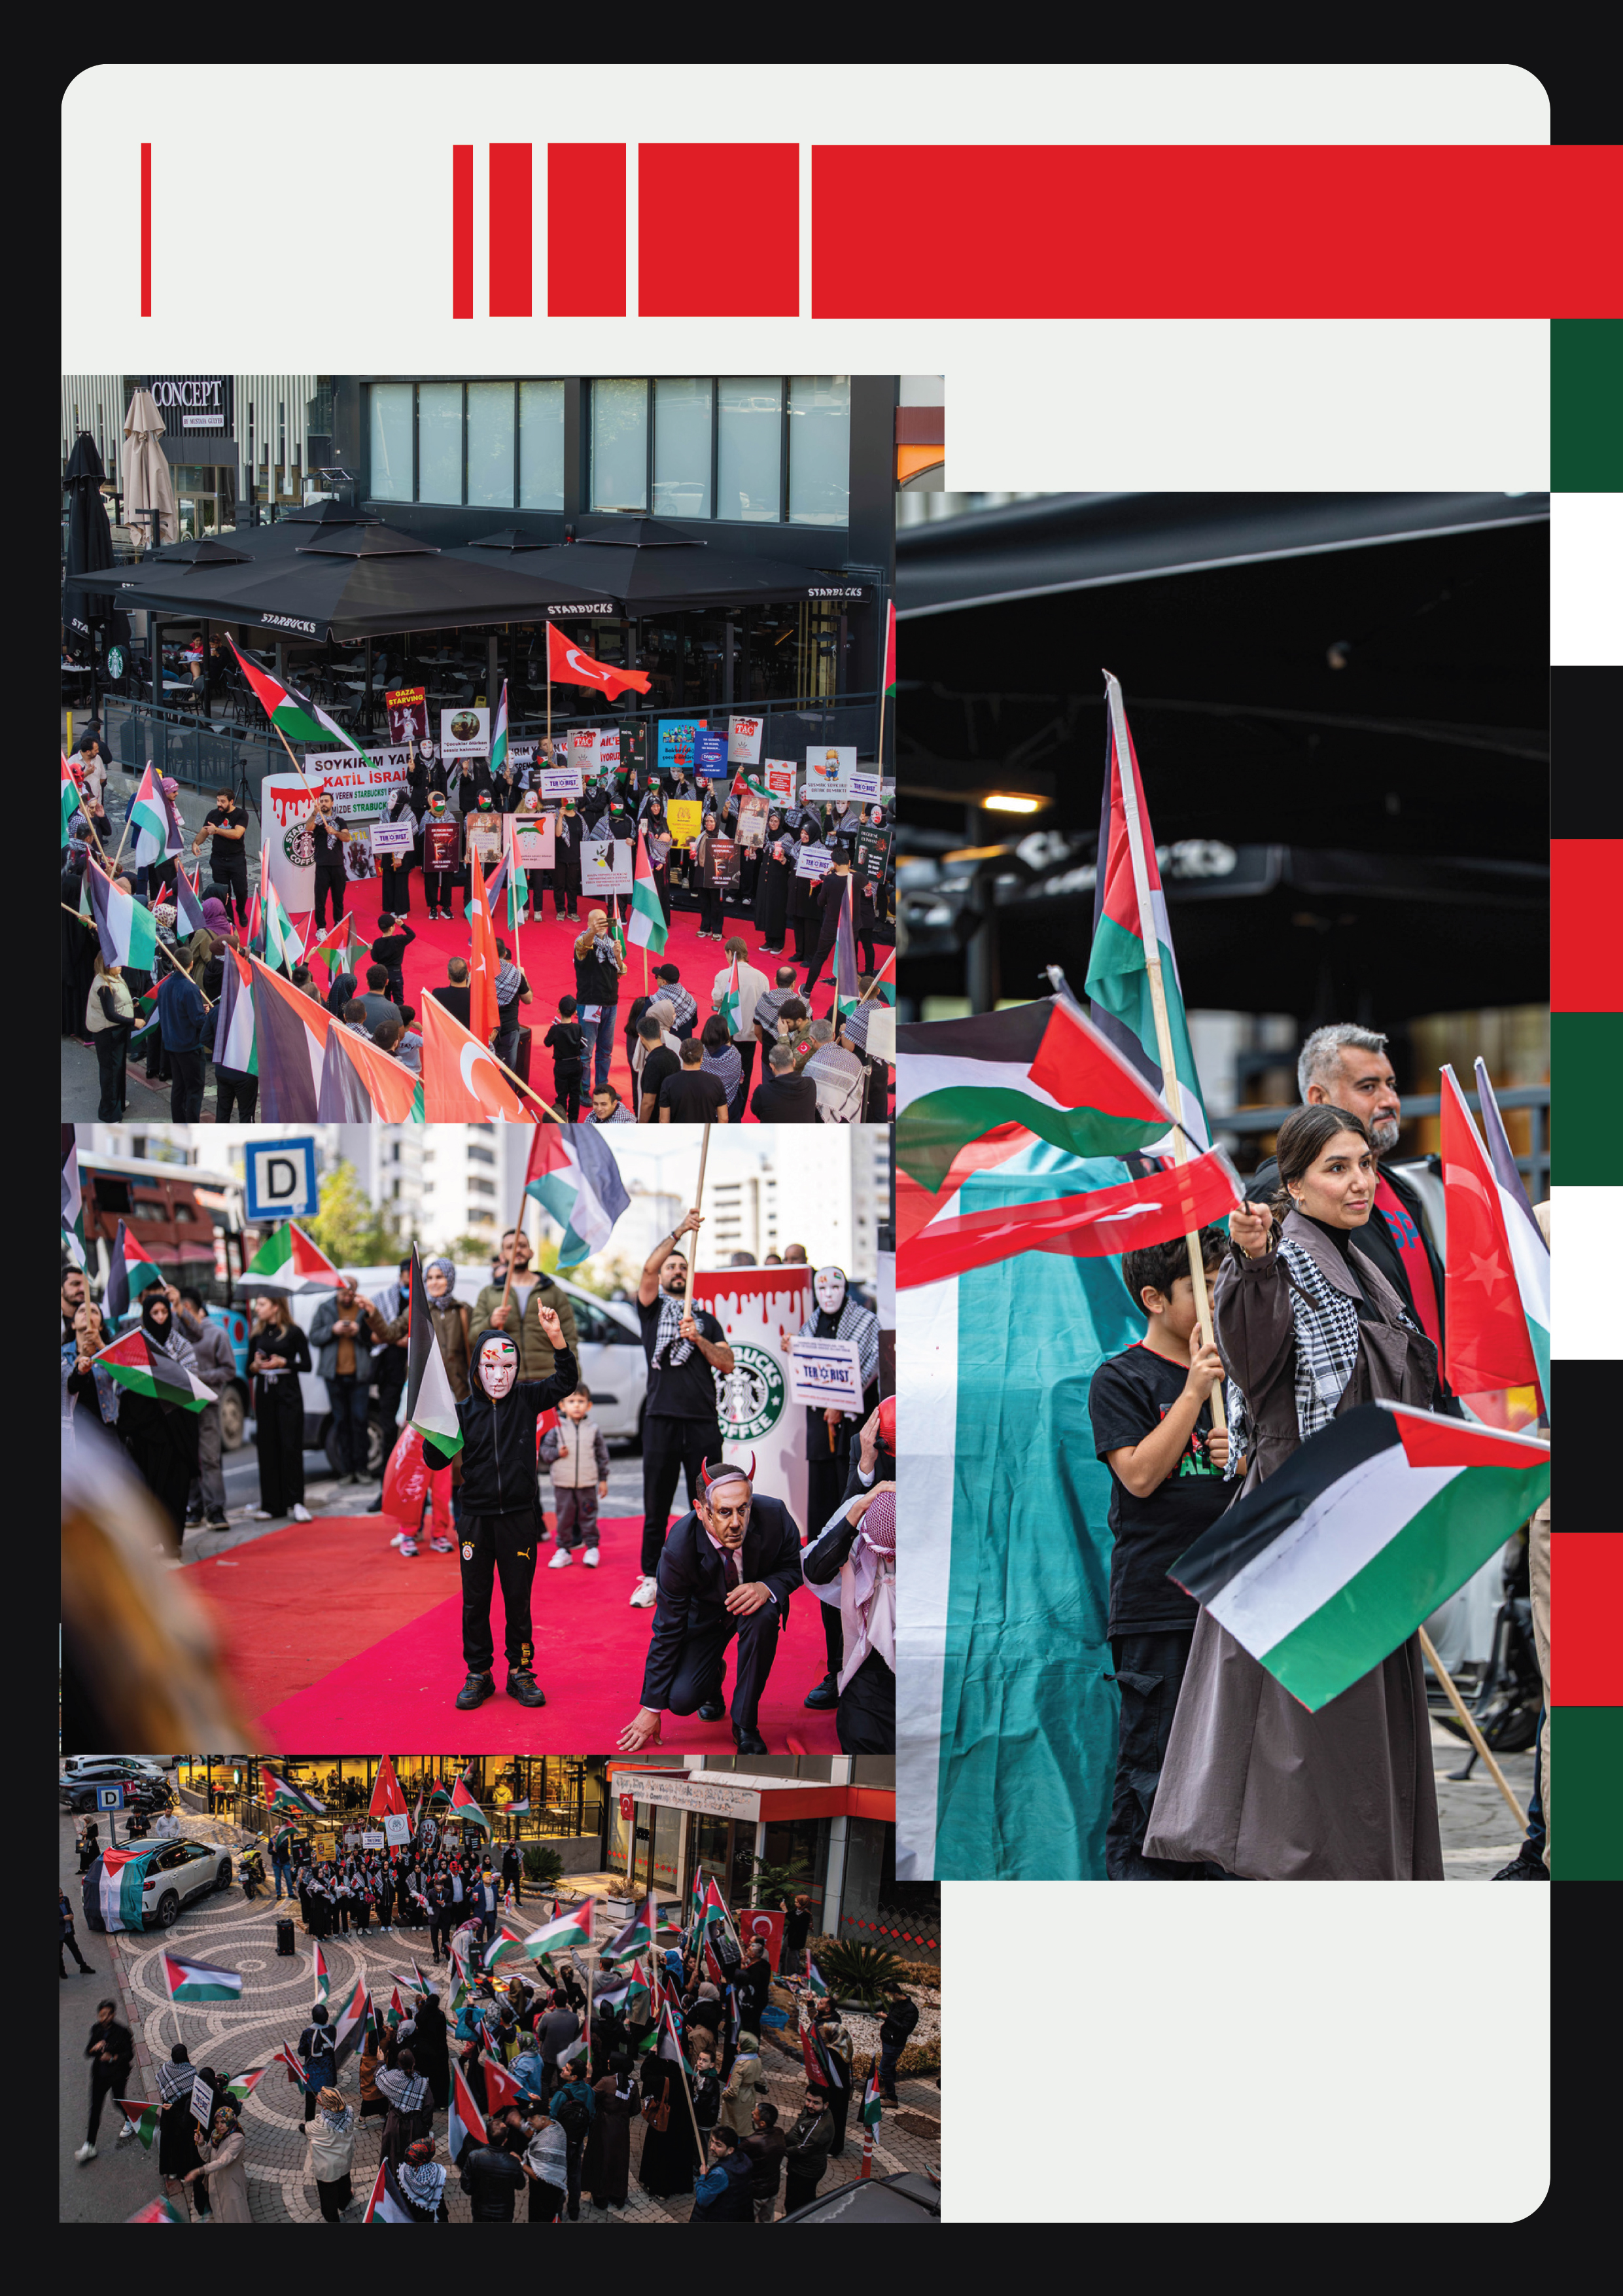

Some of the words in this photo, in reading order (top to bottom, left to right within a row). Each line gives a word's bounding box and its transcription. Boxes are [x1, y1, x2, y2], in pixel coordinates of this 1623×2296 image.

[152, 380, 222, 406] CONCEPT
[547, 603, 613, 615] STARBUCKS
[71, 618, 90, 635] STA
[261, 613, 317, 633] STARBUCKS
[389, 694, 423, 705] STARVING
[600, 735, 620, 747] AİL'E
[323, 772, 365, 788] KATİL
[369, 768, 406, 784] İSRAİ
[336, 791, 353, 800] VEREN
[353, 802, 388, 813] STRABUCK
[290, 853, 315, 865] COFFE
[268, 1157, 297, 1199] D
[733, 1346, 782, 1388] BUCKS
[718, 1412, 774, 1439] OFFEE
[105, 1791, 116, 1805] D
